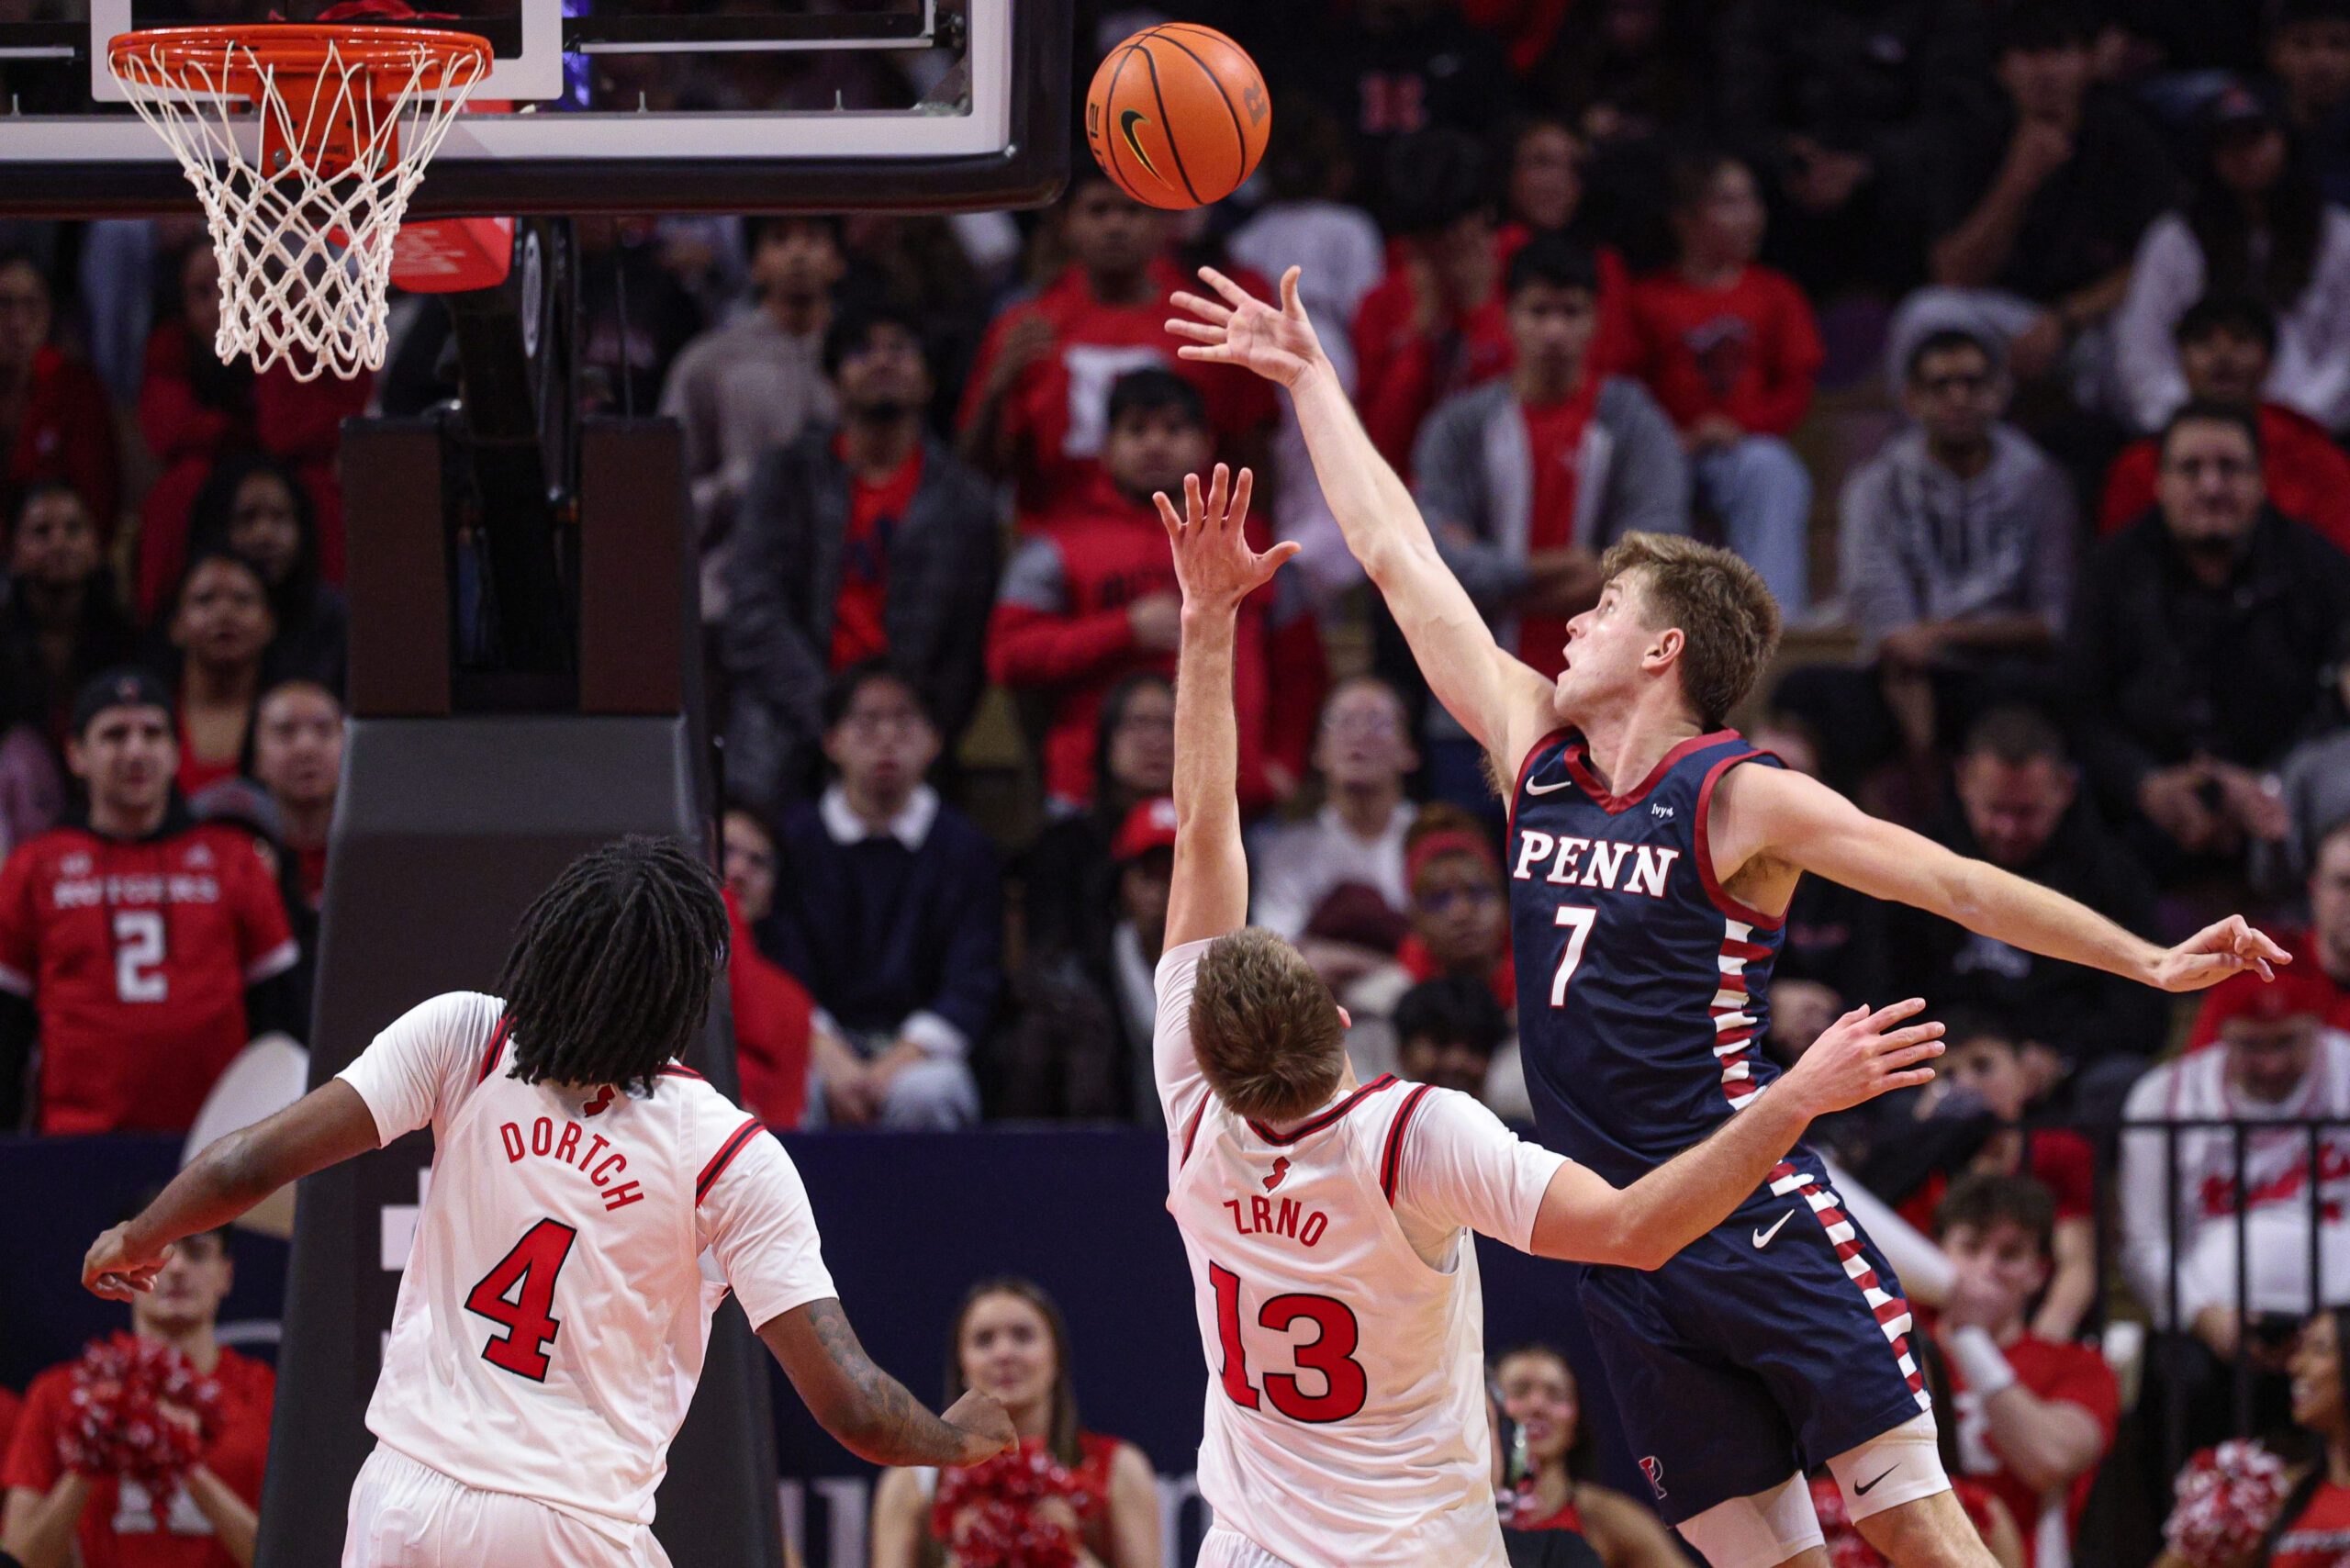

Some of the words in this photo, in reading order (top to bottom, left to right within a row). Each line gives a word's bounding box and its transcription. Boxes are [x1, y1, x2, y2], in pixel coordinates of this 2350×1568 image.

[1651, 803, 1667, 819] Ivy
[1513, 830, 1679, 898] PENN
[114, 911, 167, 1002] 2
[1550, 905, 1597, 1007] 7
[500, 1116, 644, 1211] DORTCH
[1223, 1195, 1327, 1247] ZRNO
[464, 1217, 577, 1383] 4
[1209, 1260, 1367, 1423] 13
